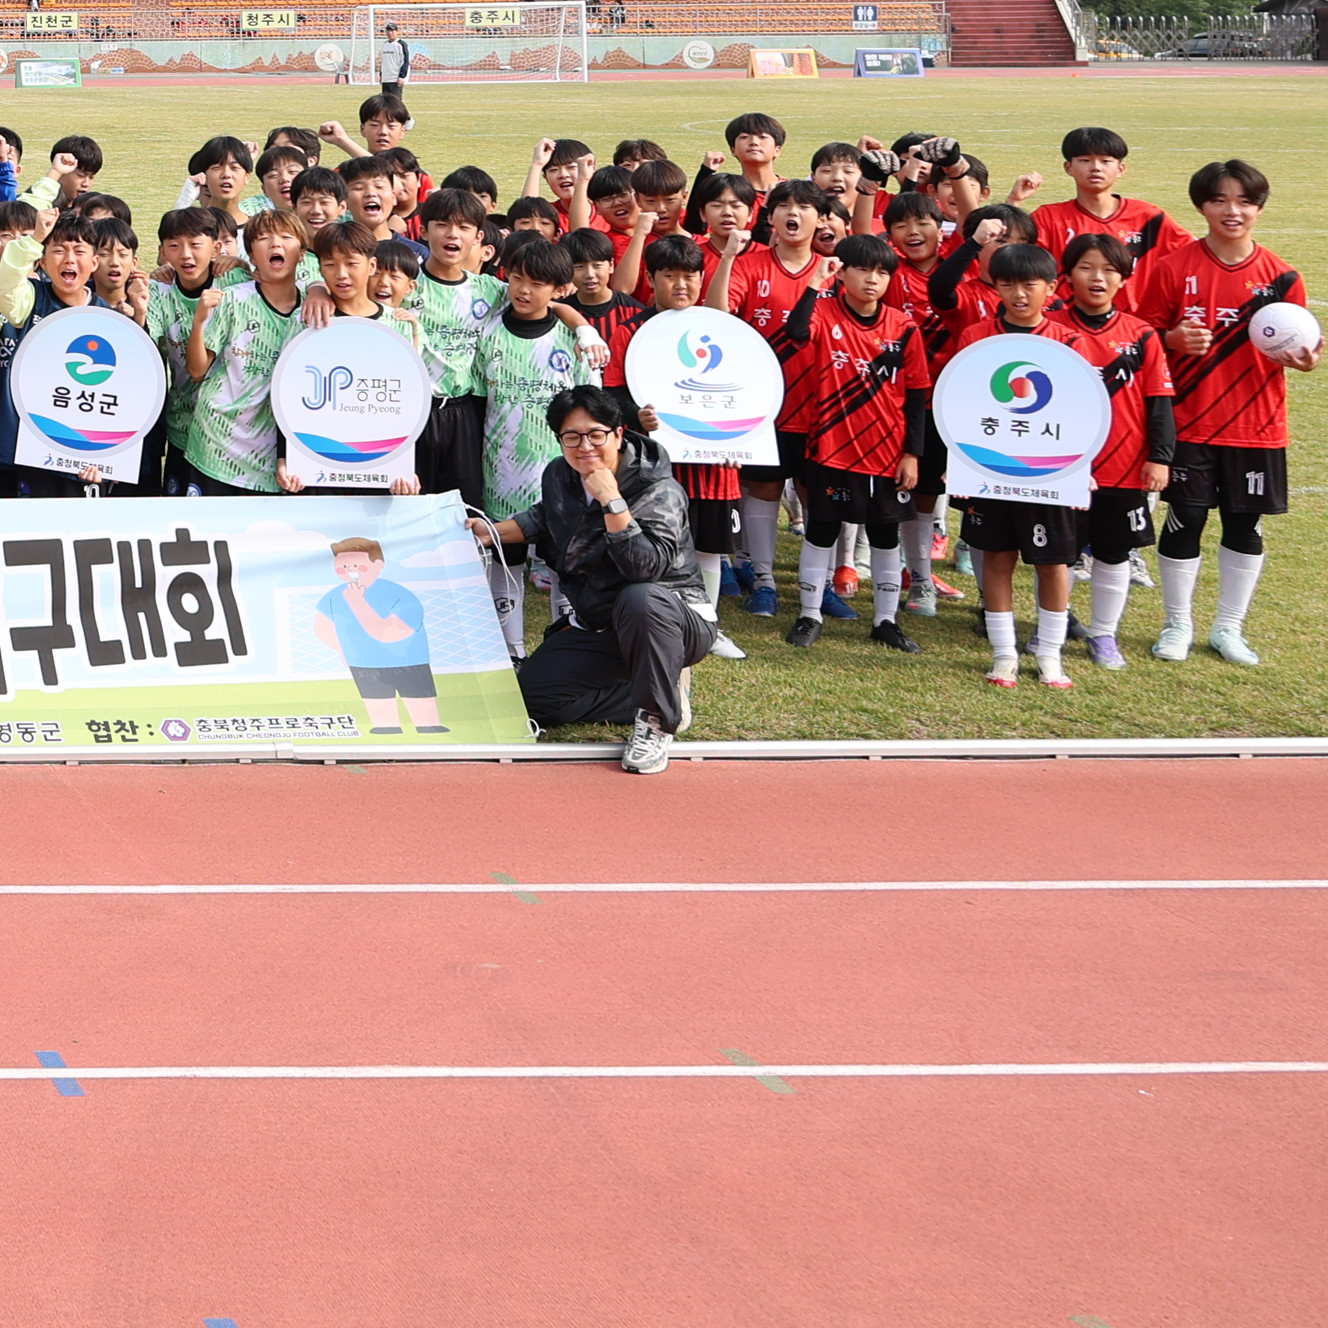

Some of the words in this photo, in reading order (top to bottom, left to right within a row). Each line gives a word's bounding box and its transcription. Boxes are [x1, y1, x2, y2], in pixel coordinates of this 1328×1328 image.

[31, 15, 73, 28] 진천군
[246, 13, 290, 26] 청주시
[470, 11, 515, 24] 충주시
[831, 350, 897, 385] 충주시
[356, 378, 401, 403] 증평군
[52, 386, 119, 416] 음성군
[339, 404, 365, 415] Jeung
[368, 404, 401, 415] Pyeong
[678, 394, 737, 409] 보은군
[980, 416, 1060, 441] 충주시
[694, 450, 753, 460] 충청북도체육회
[329, 472, 389, 483] 충청북도체육회
[1245, 471, 1265, 496] 11
[993, 485, 1059, 500] 충청북도체육회
[1127, 506, 1147, 532] 13
[1033, 523, 1047, 547] 8
[85, 719, 140, 743] 협찬
[195, 716, 355, 733] 충북청주프로축구단
